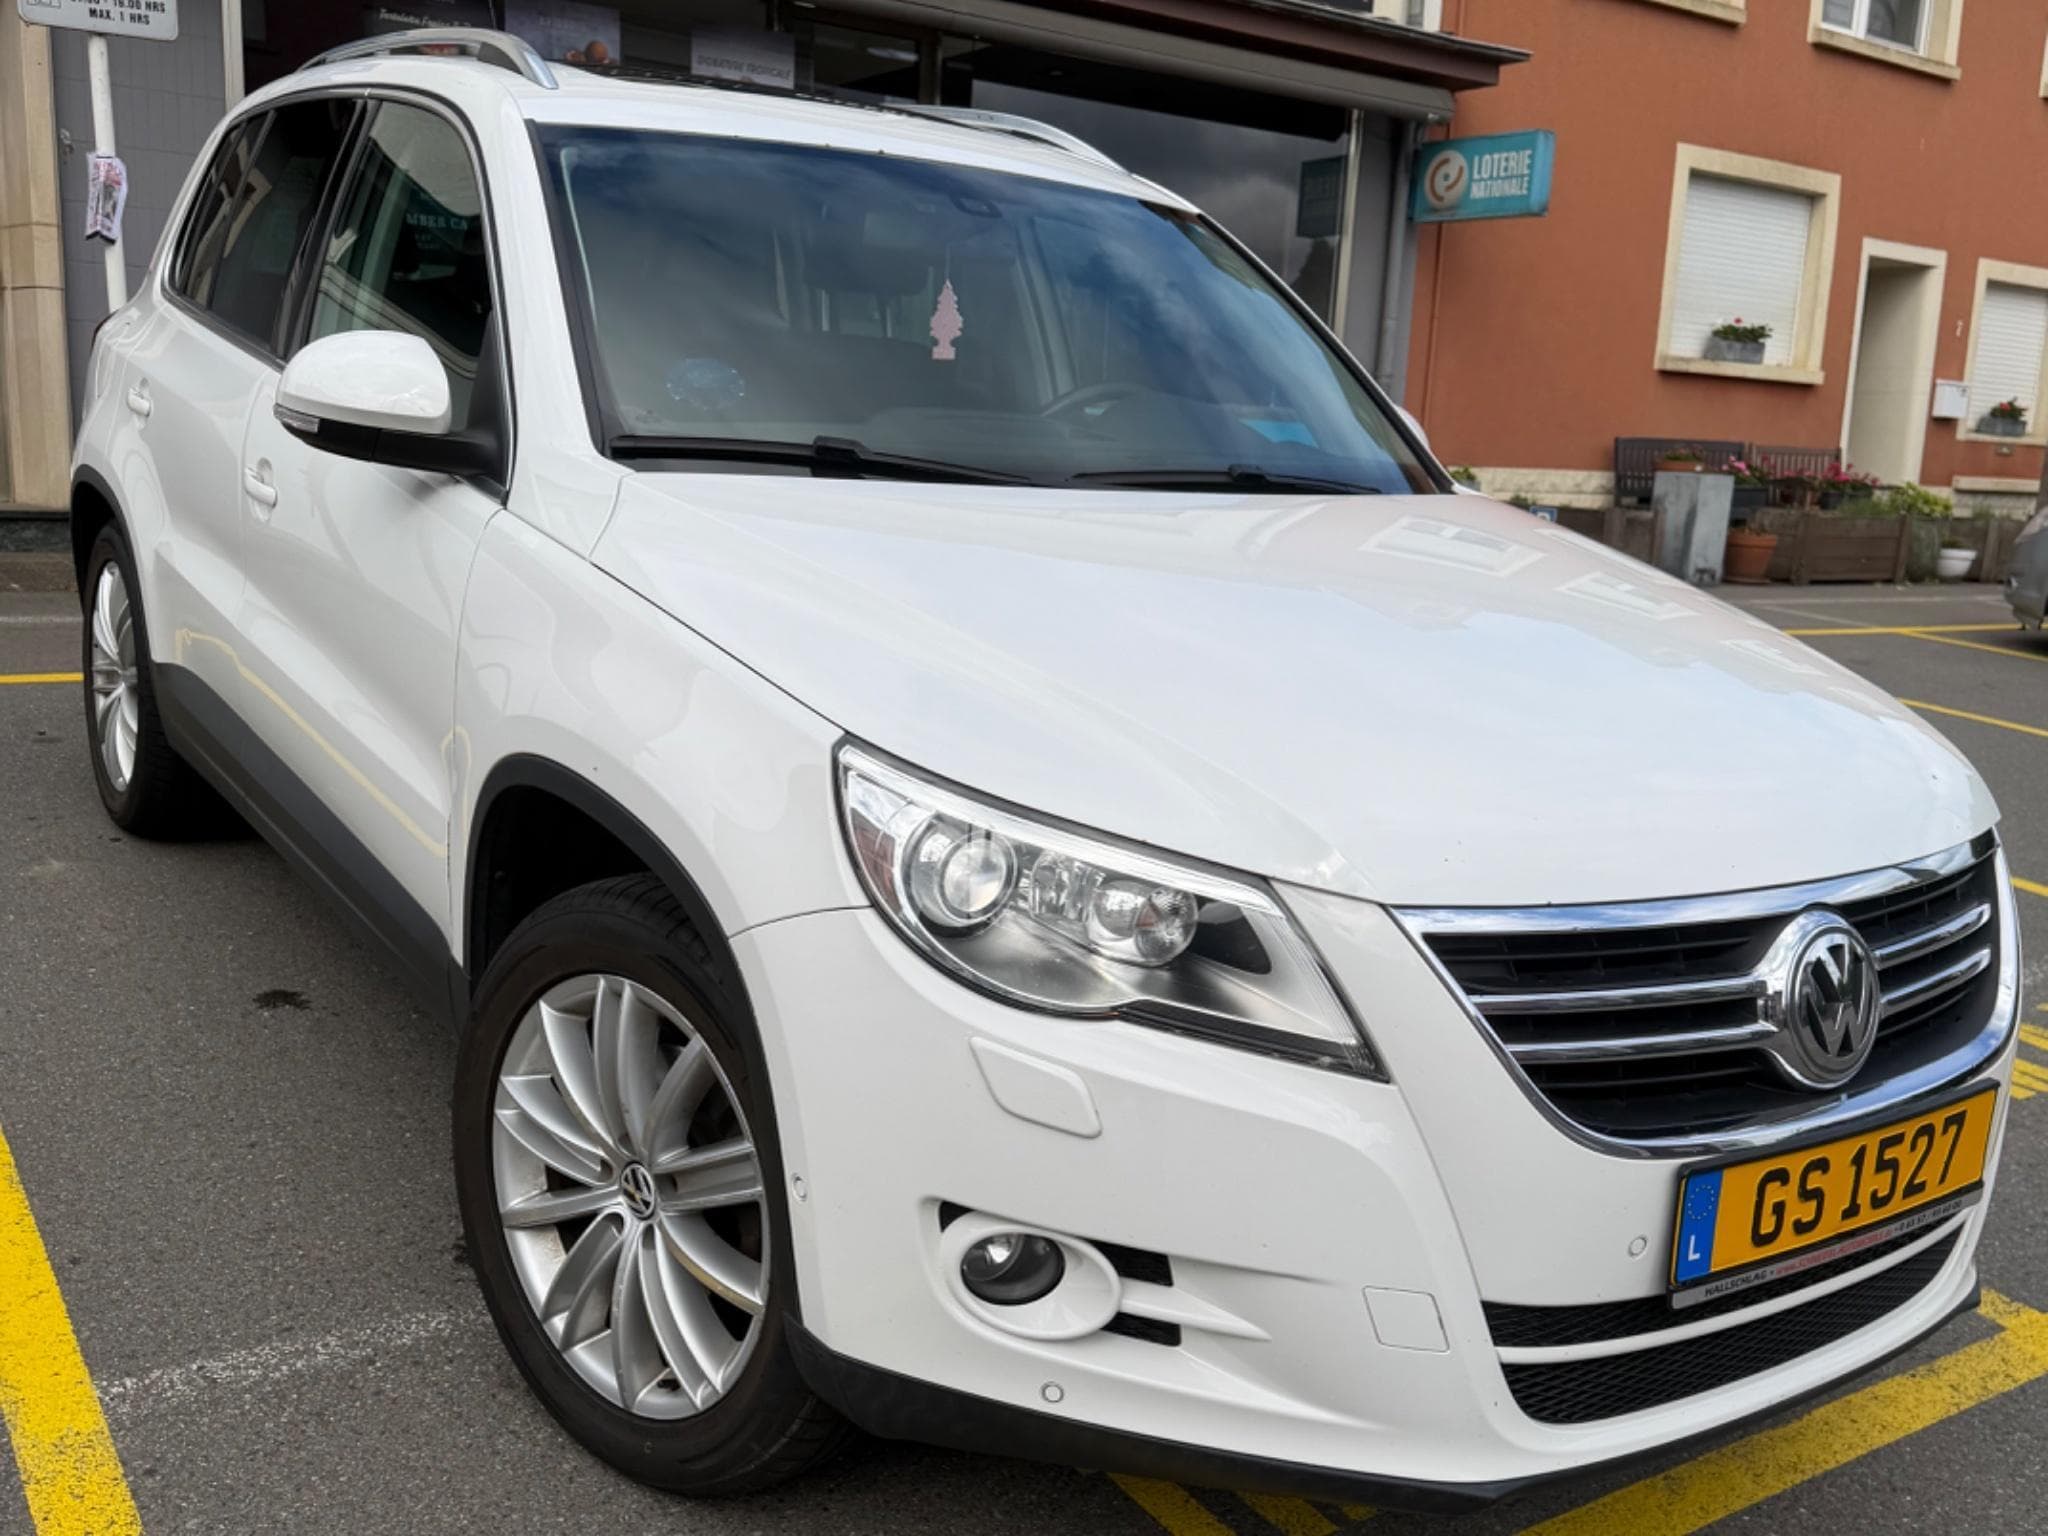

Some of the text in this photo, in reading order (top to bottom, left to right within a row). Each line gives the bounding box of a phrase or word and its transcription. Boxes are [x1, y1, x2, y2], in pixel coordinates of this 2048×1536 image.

[88, 7, 115, 21] MAX.
[129, 13, 150, 25] HRS
[145, 1, 165, 13] HRS
[1473, 149, 1532, 179] LOTERIE
[1470, 176, 1529, 199] NATIONALE
[1751, 1109, 1967, 1248] GS 1527
[1687, 1234, 1701, 1262] L
